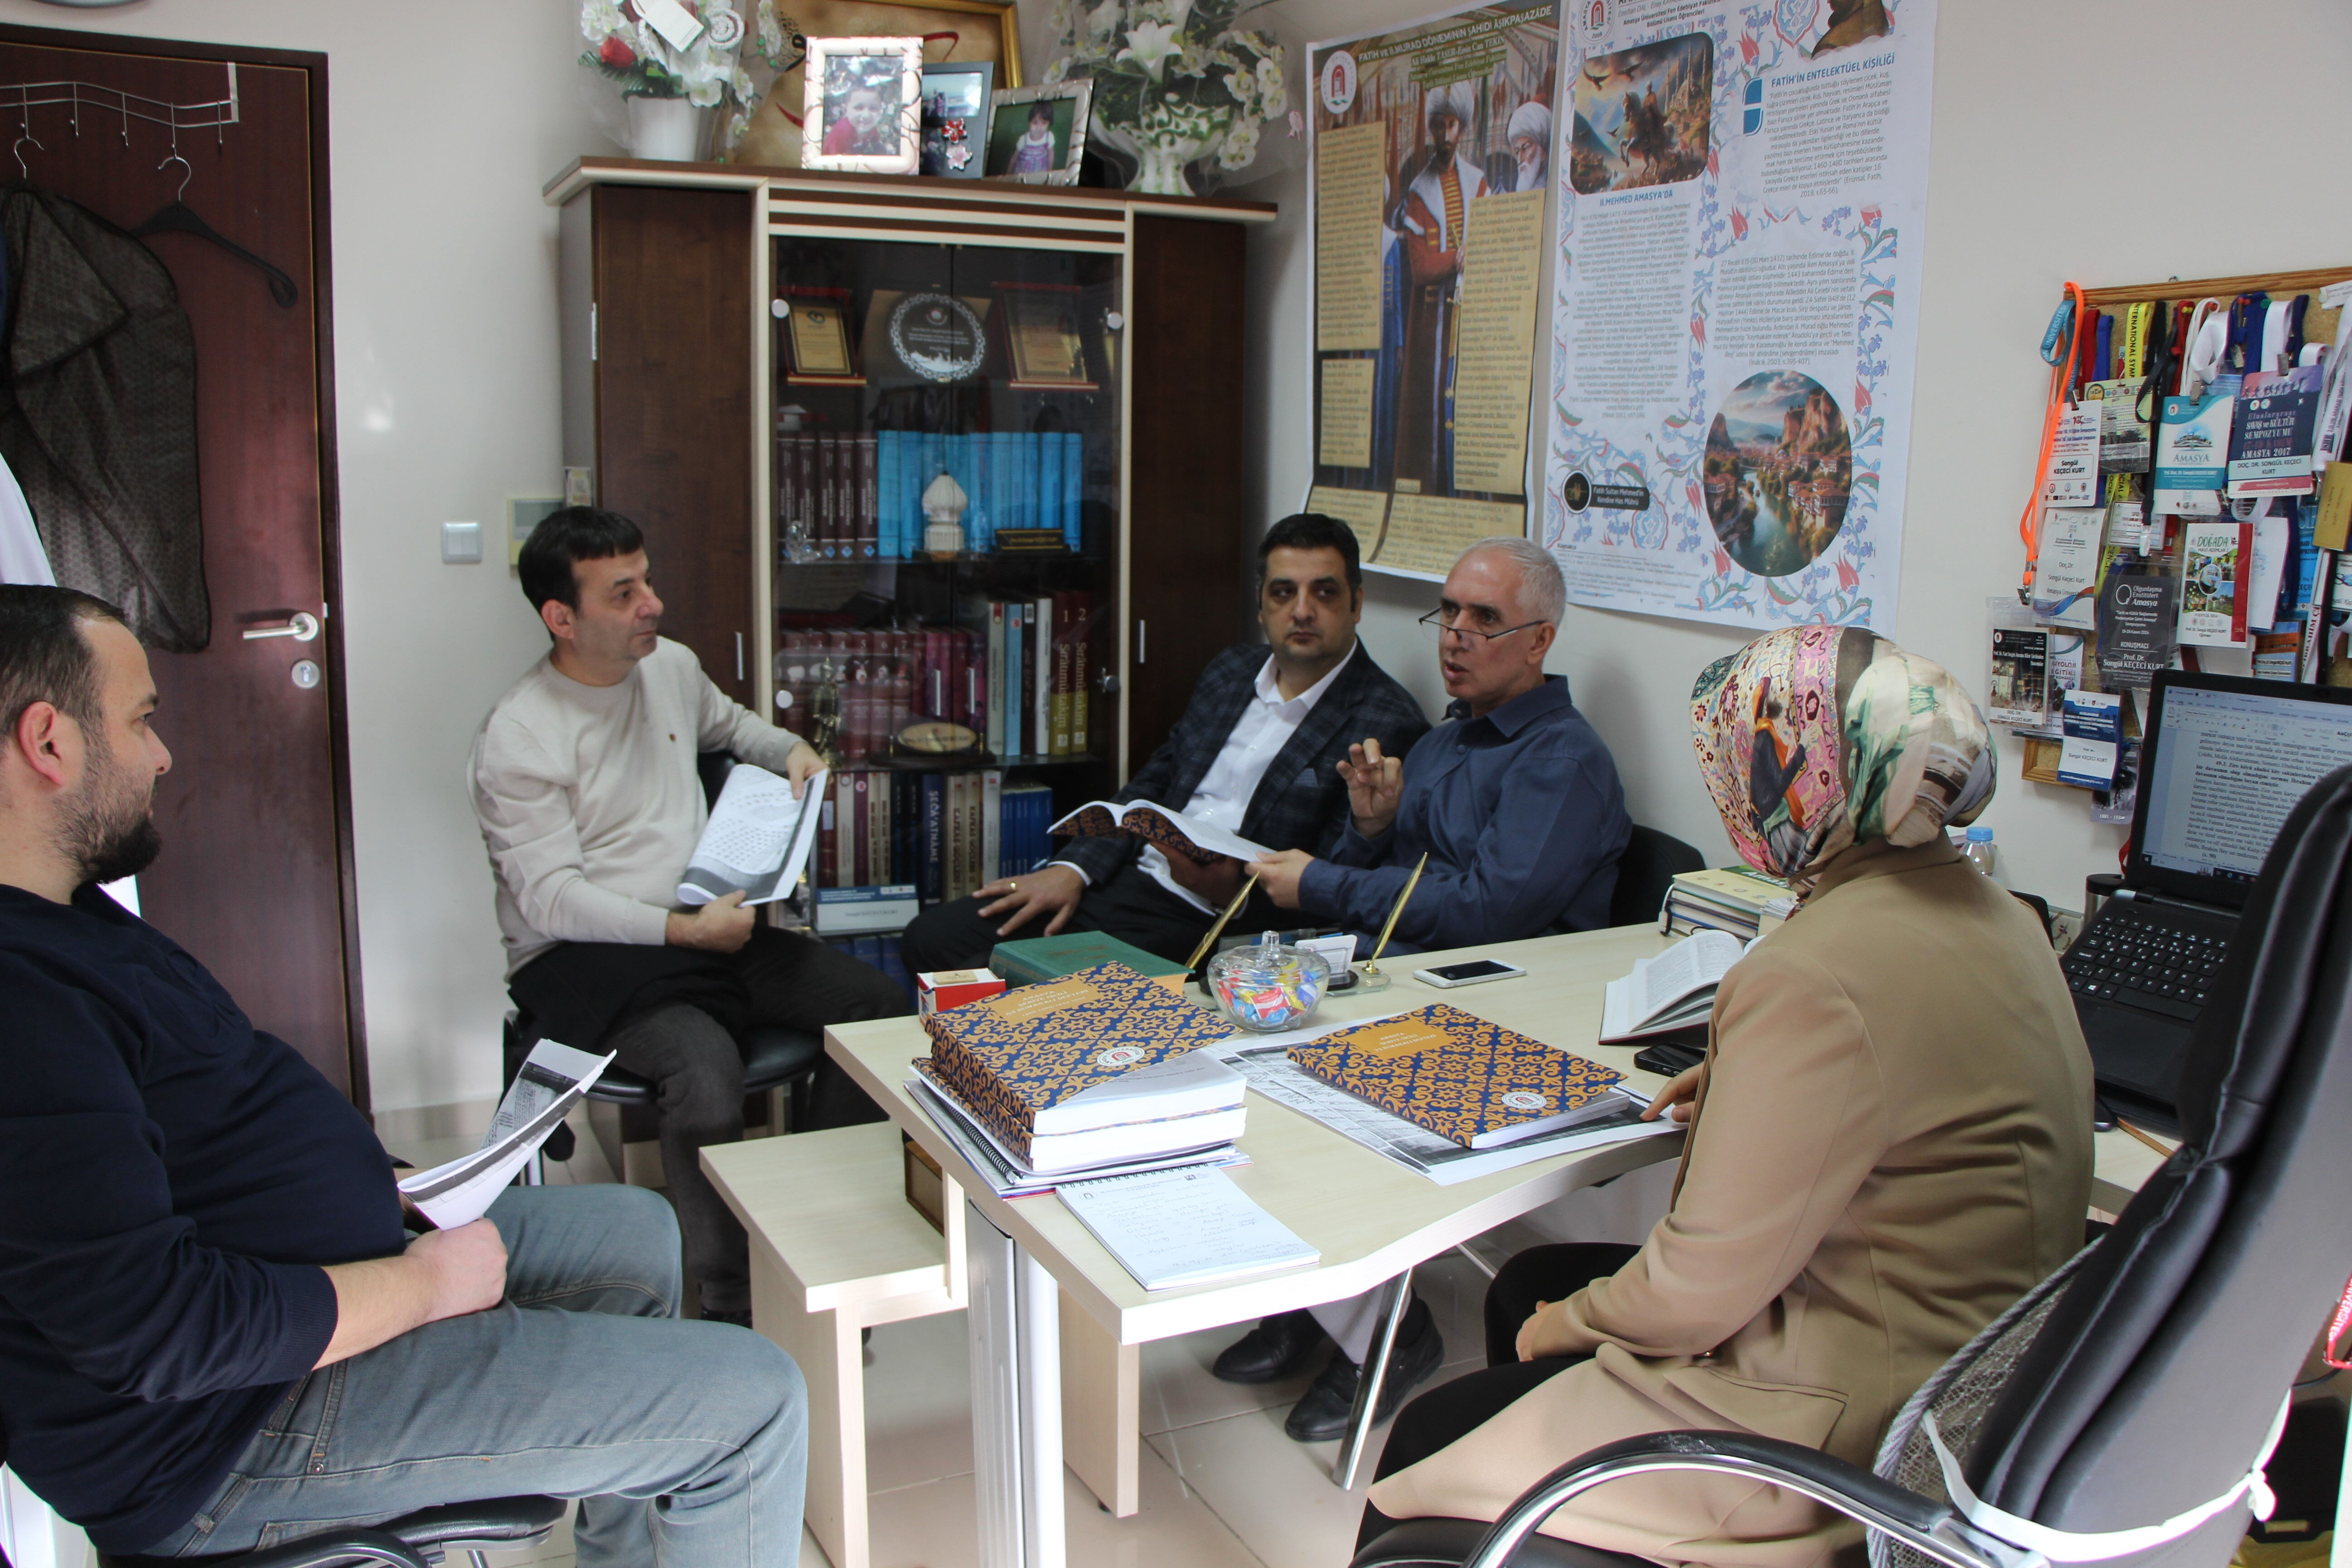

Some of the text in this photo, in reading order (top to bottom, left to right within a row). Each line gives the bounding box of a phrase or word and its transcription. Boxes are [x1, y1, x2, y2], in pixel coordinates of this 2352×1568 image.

[1623, 17, 1640, 26] Amasya
[1641, 10, 1667, 21] Üniversitesi
[1677, 3, 1698, 13] Edebiyat
[1647, 10, 1705, 28] Bölümü Lisans Öğrencileri
[1771, 52, 1895, 88] FATİH'İN ENTELEKTÜEL KİŞİLİĞİ
[1865, 80, 1891, 90] Müslüman
[1829, 98, 1840, 106] Grek
[1848, 93, 1868, 103] Osmanlı
[1842, 103, 1860, 112] Fatih'in
[1862, 100, 1881, 110] Arapça
[1817, 117, 1834, 125] Latince
[1819, 125, 1834, 133] Yunan
[1842, 120, 1866, 129] Roma'nın
[1846, 146, 1882, 157] teşebbüslerde
[1865, 154, 1887, 162] arasında
[1853, 165, 1872, 174] katipler
[1634, 190, 1673, 202] AMASYA'DA
[2241, 447, 2290, 459] AMASYA 2017
[2061, 460, 2078, 468] Songül
[2053, 467, 2070, 475] KEÇECİ
[2197, 534, 2228, 547] DOĞADA
[2132, 598, 2157, 608] Amasya
[1078, 608, 1086, 621] 2
[861, 640, 866, 648] 5
[2103, 659, 2122, 668] Songül
[2124, 661, 2146, 670] KEÇECİ
